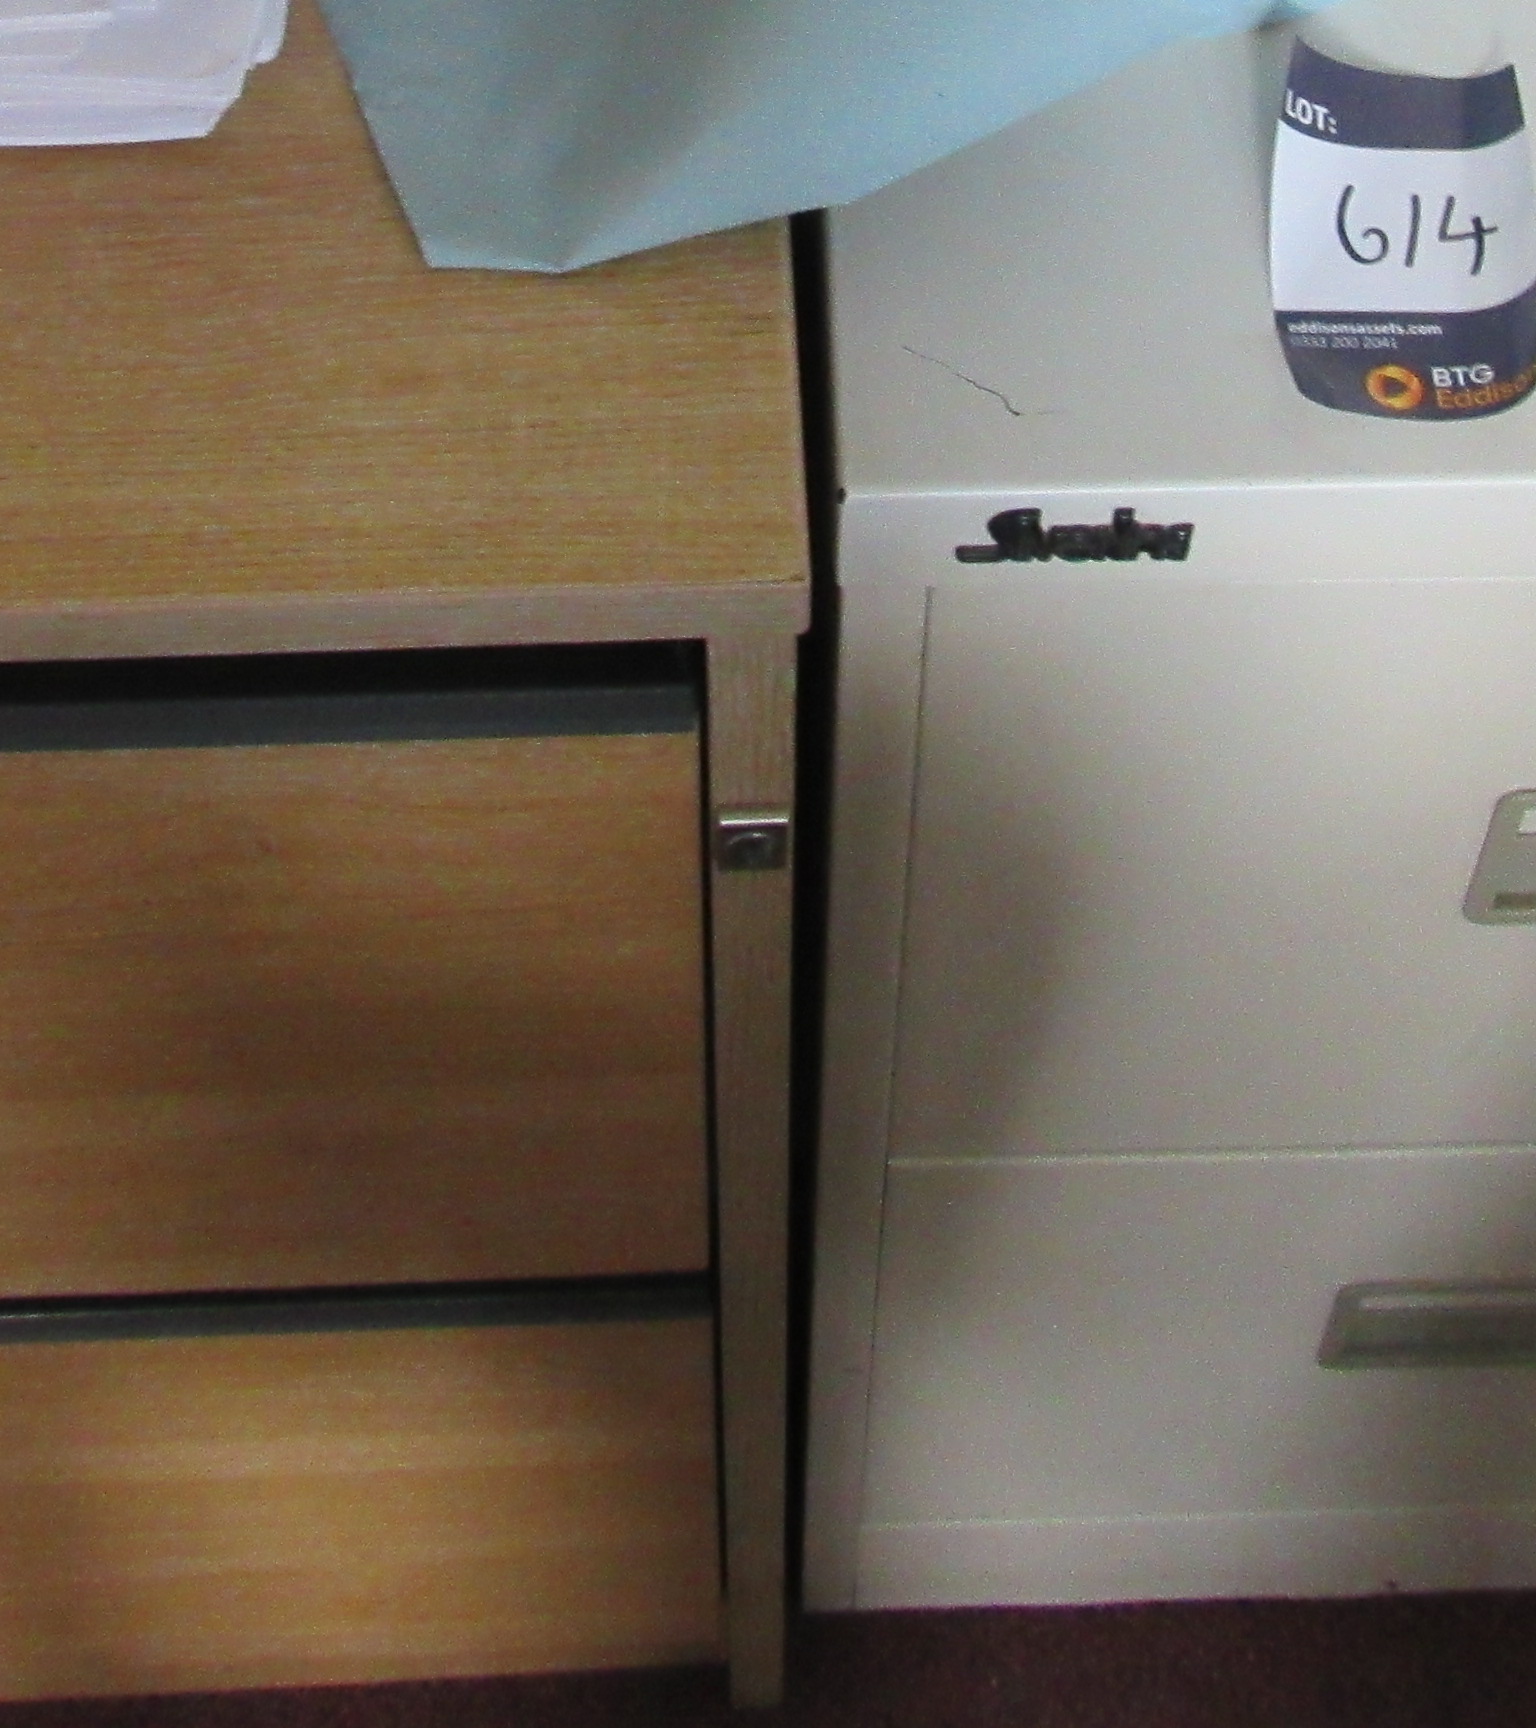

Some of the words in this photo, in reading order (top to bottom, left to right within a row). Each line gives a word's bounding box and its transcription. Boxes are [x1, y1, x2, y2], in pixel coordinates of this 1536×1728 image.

[1283, 89, 1338, 135] LOT:
[1335, 184, 1500, 276] 614
[1430, 363, 1496, 388] BTG
